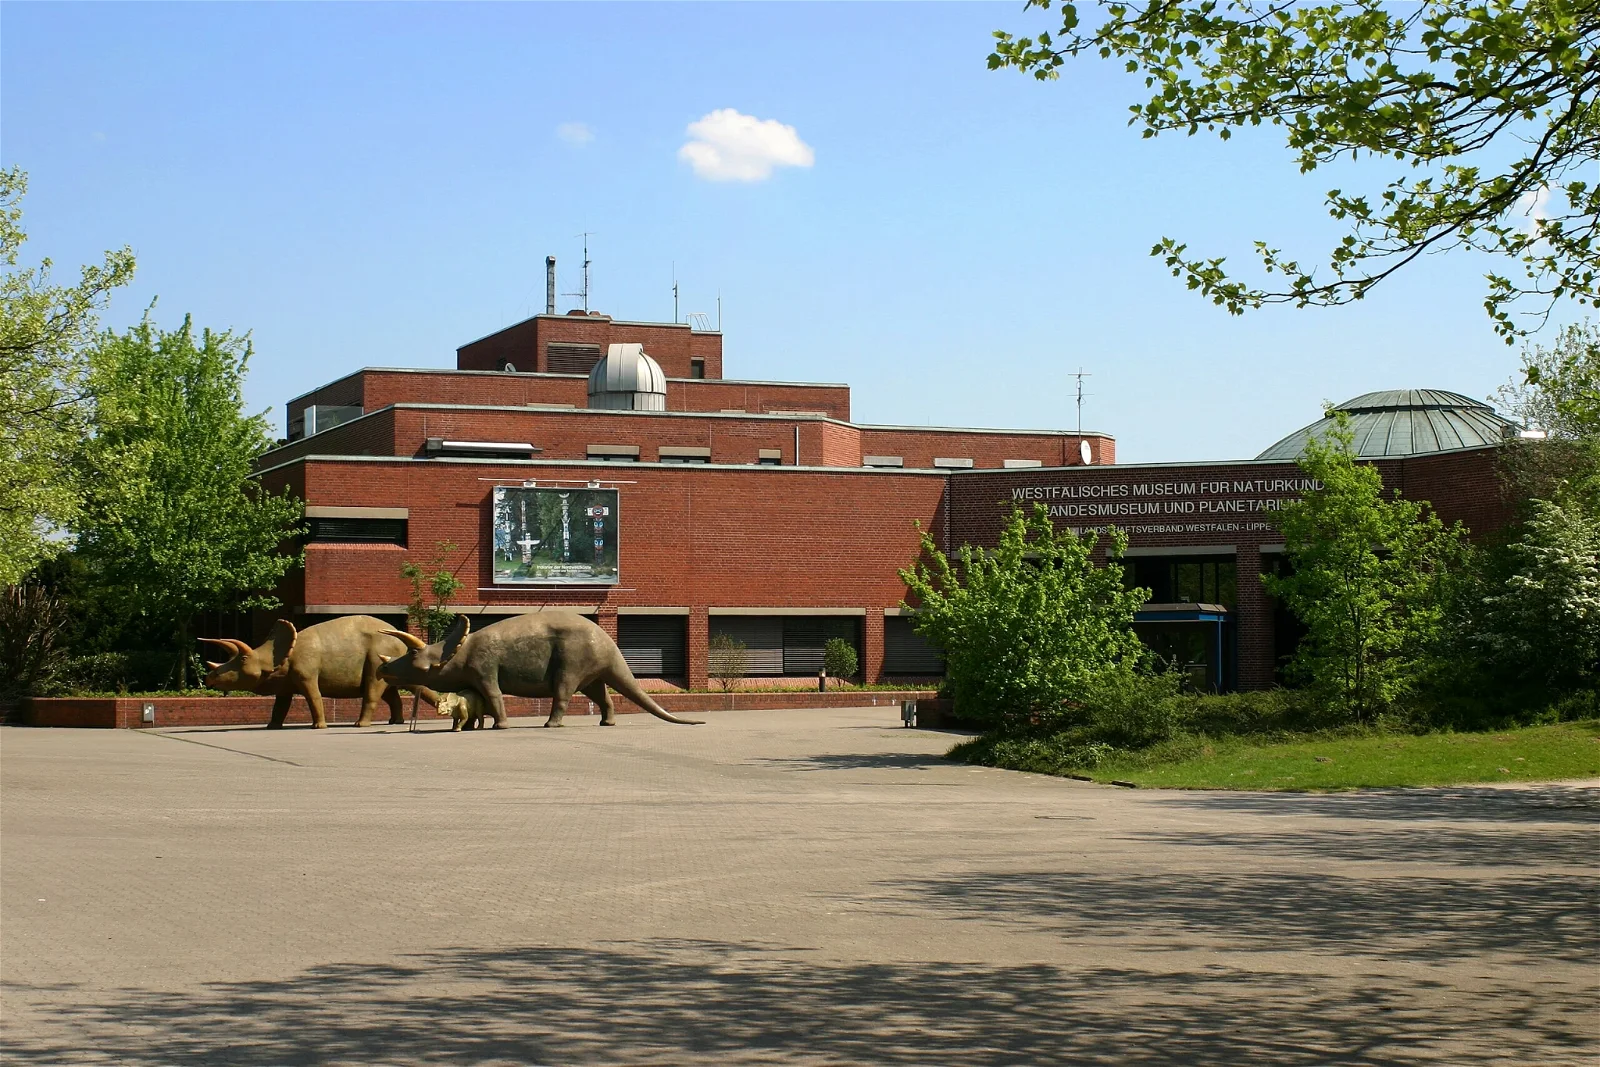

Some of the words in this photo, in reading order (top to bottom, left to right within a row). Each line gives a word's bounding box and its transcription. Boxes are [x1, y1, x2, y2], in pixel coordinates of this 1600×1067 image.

[1012, 484, 1129, 499] WESTFÄLISCHES
[1133, 482, 1196, 496] MUSEUM
[1200, 481, 1230, 494] FÜR
[1233, 479, 1325, 493] NATURKUND
[1164, 501, 1195, 514] UND
[1079, 524, 1184, 535] LANDSHAFTSVERBAND
[1185, 523, 1239, 532] WESTFALEN
[1246, 522, 1272, 531] LIPPE
